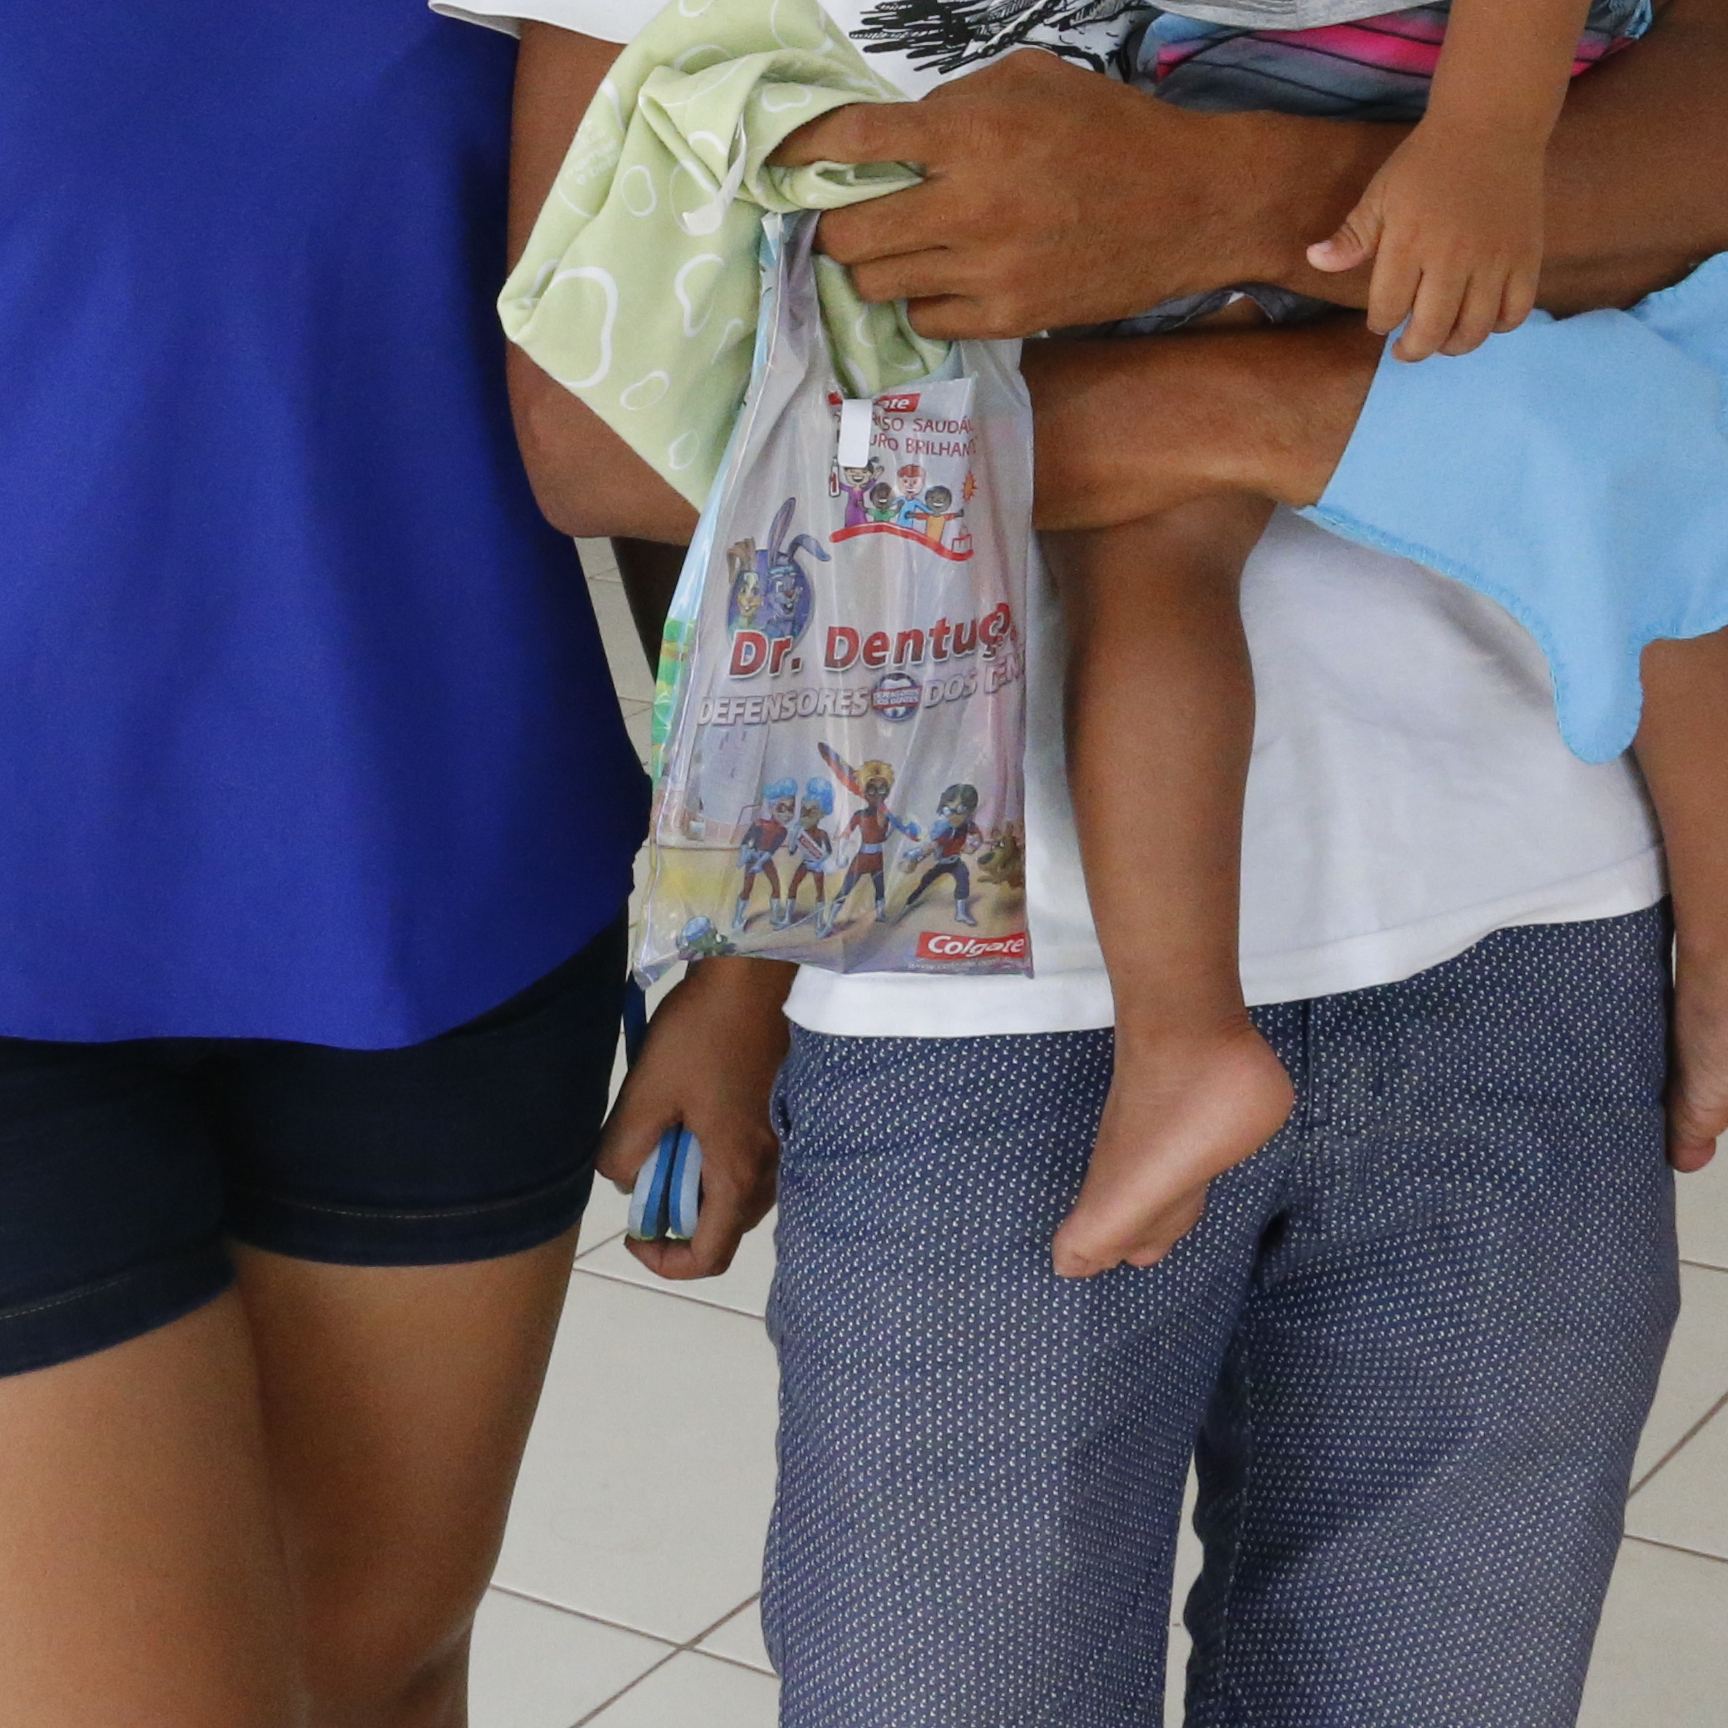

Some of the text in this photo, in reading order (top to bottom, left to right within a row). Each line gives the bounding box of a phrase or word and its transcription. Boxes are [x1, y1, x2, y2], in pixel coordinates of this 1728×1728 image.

[729, 628, 803, 681] Dr.
[697, 687, 870, 726] DEFENSORES
[924, 672, 978, 709] DOS
[927, 935, 1025, 958] Colgate
